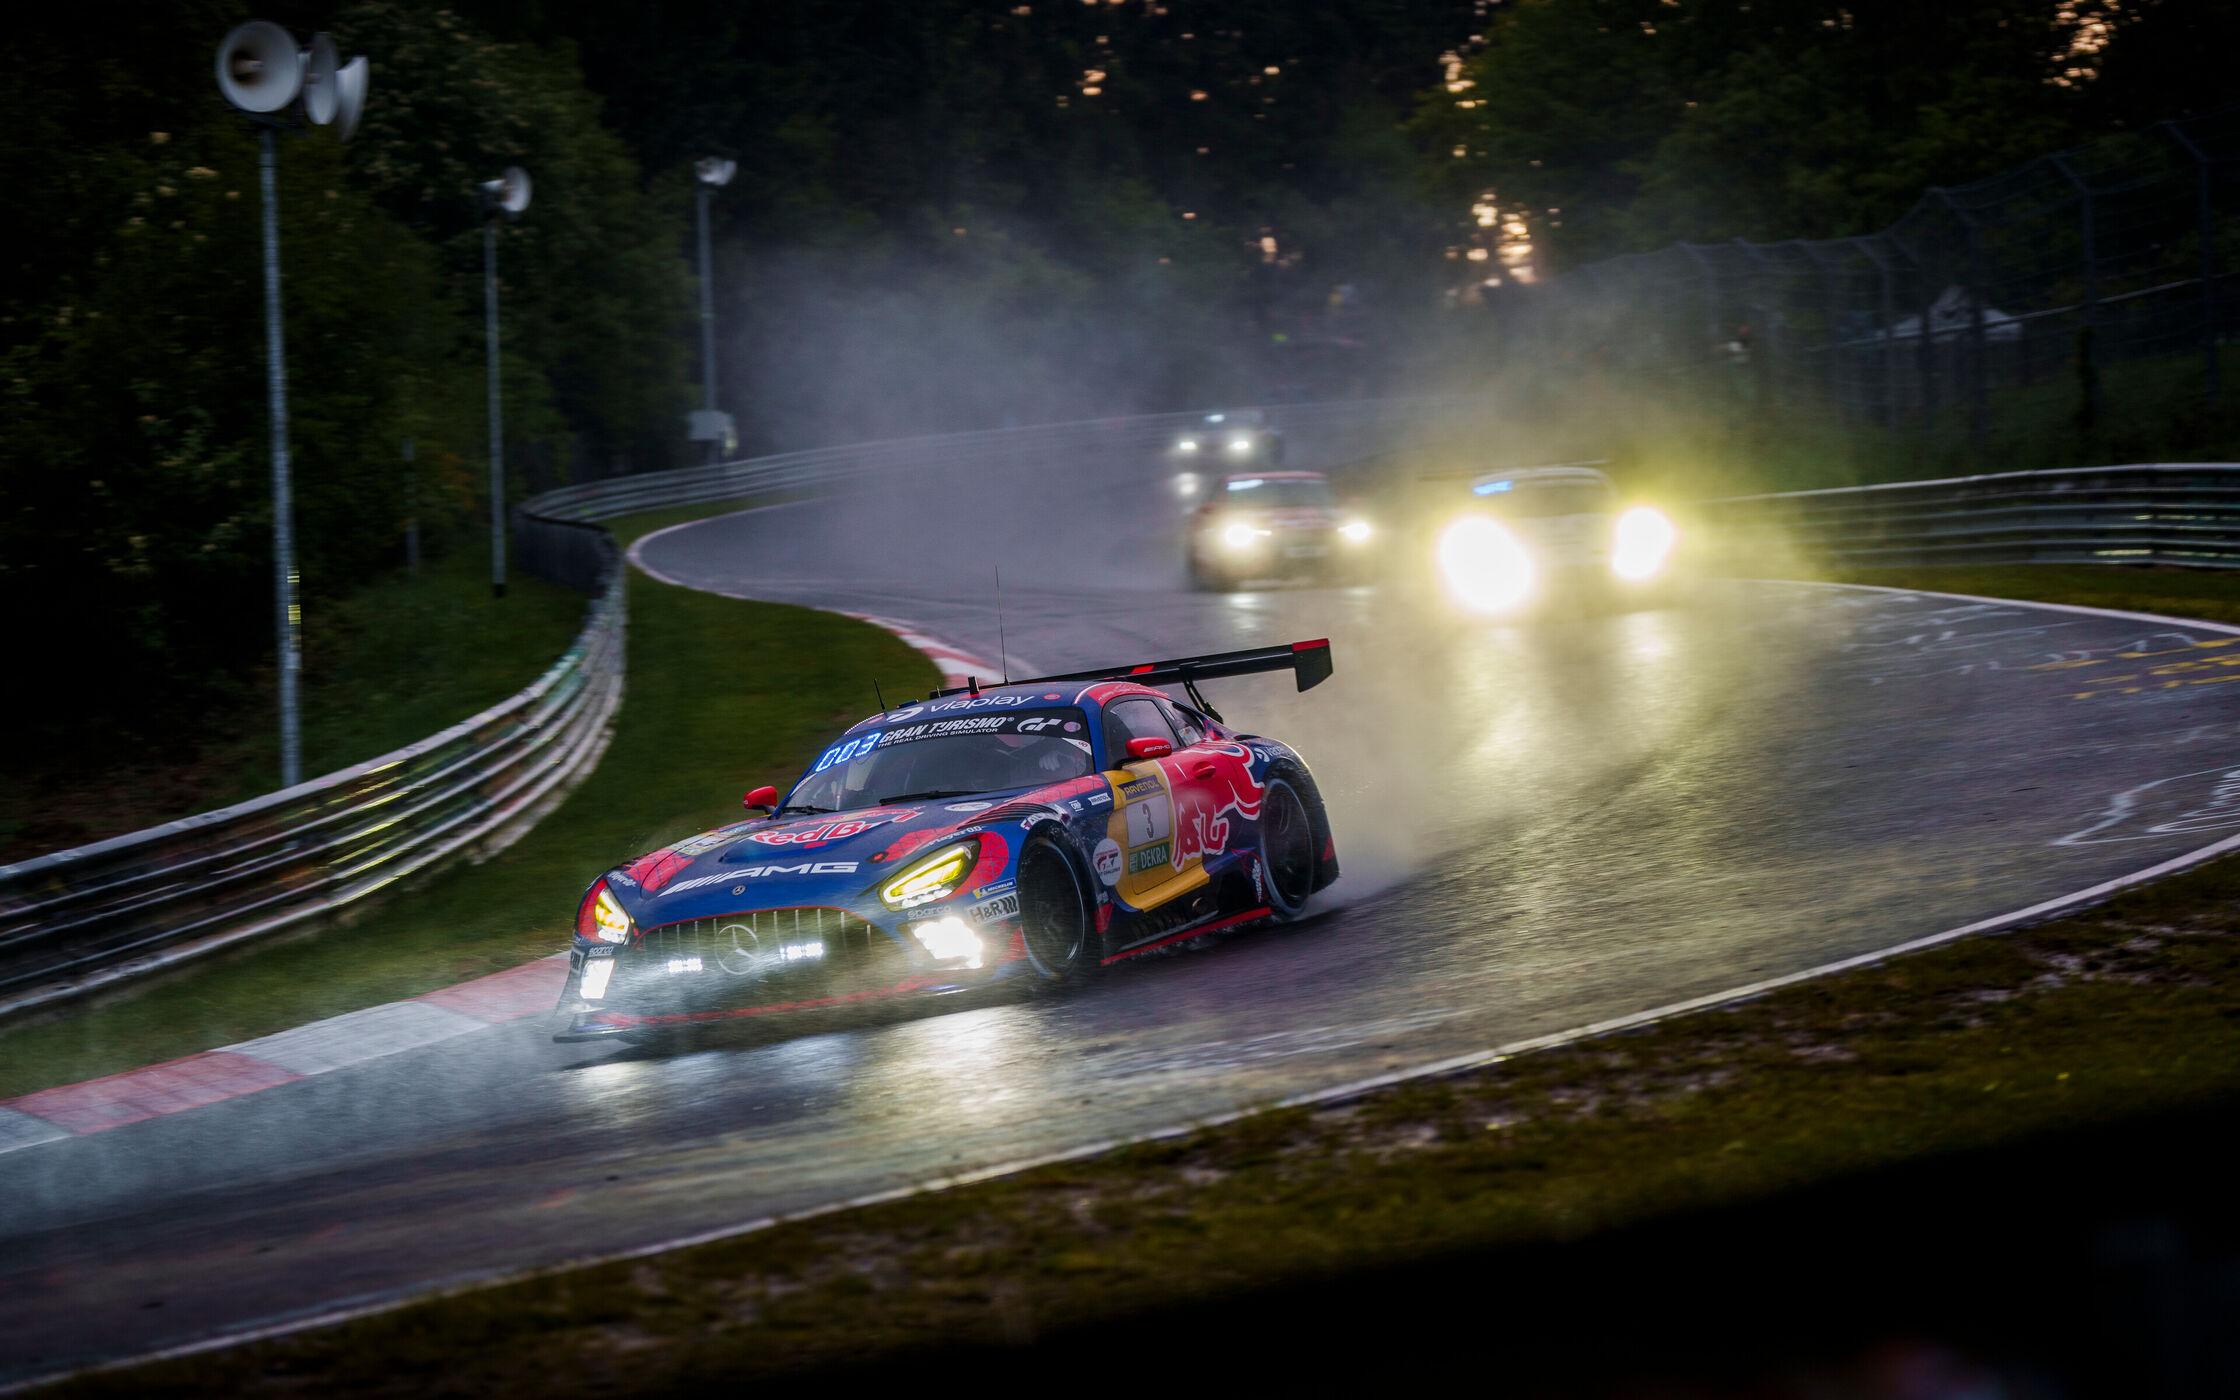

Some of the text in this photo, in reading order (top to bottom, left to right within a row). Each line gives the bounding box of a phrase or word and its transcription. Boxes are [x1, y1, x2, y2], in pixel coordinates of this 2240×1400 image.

[877, 727, 999, 748] THE REAL DRIVING SIMULATOR
[879, 723, 929, 744] GRAN
[815, 732, 882, 772] 003
[1124, 780, 1160, 796] RAVENOL
[1142, 803, 1155, 839] 3
[750, 823, 830, 847] Red
[1140, 846, 1168, 870] DEKRA
[712, 861, 860, 884] AMG
[907, 905, 952, 919] sparco
[970, 901, 1004, 922] H&R
